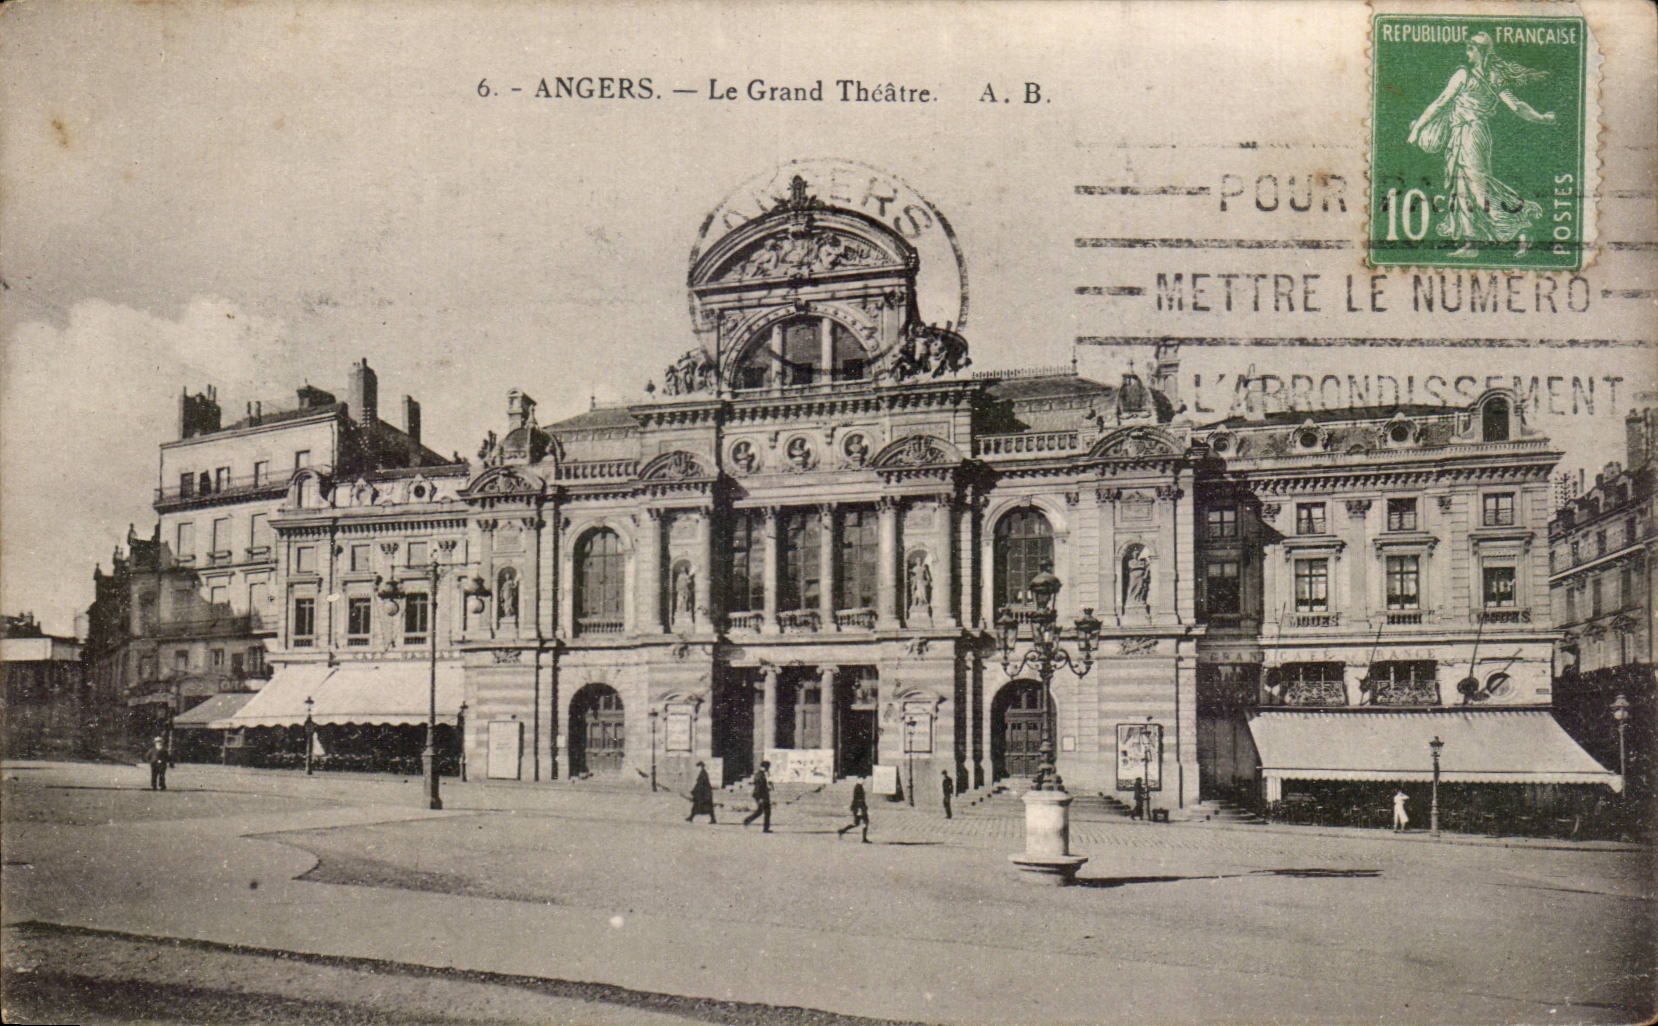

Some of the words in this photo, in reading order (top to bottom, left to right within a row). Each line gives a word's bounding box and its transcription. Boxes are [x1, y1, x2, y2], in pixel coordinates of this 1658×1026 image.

[1383, 24, 1468, 42] REPUBLIQUE
[1496, 27, 1577, 45] FRANÇAISE
[1220, 174, 1347, 212] POUR
[1552, 173, 1573, 255] POSTES
[1156, 272, 1321, 313] METTRE
[1346, 273, 1388, 313] LE
[1413, 274, 1590, 314] NUMERO
